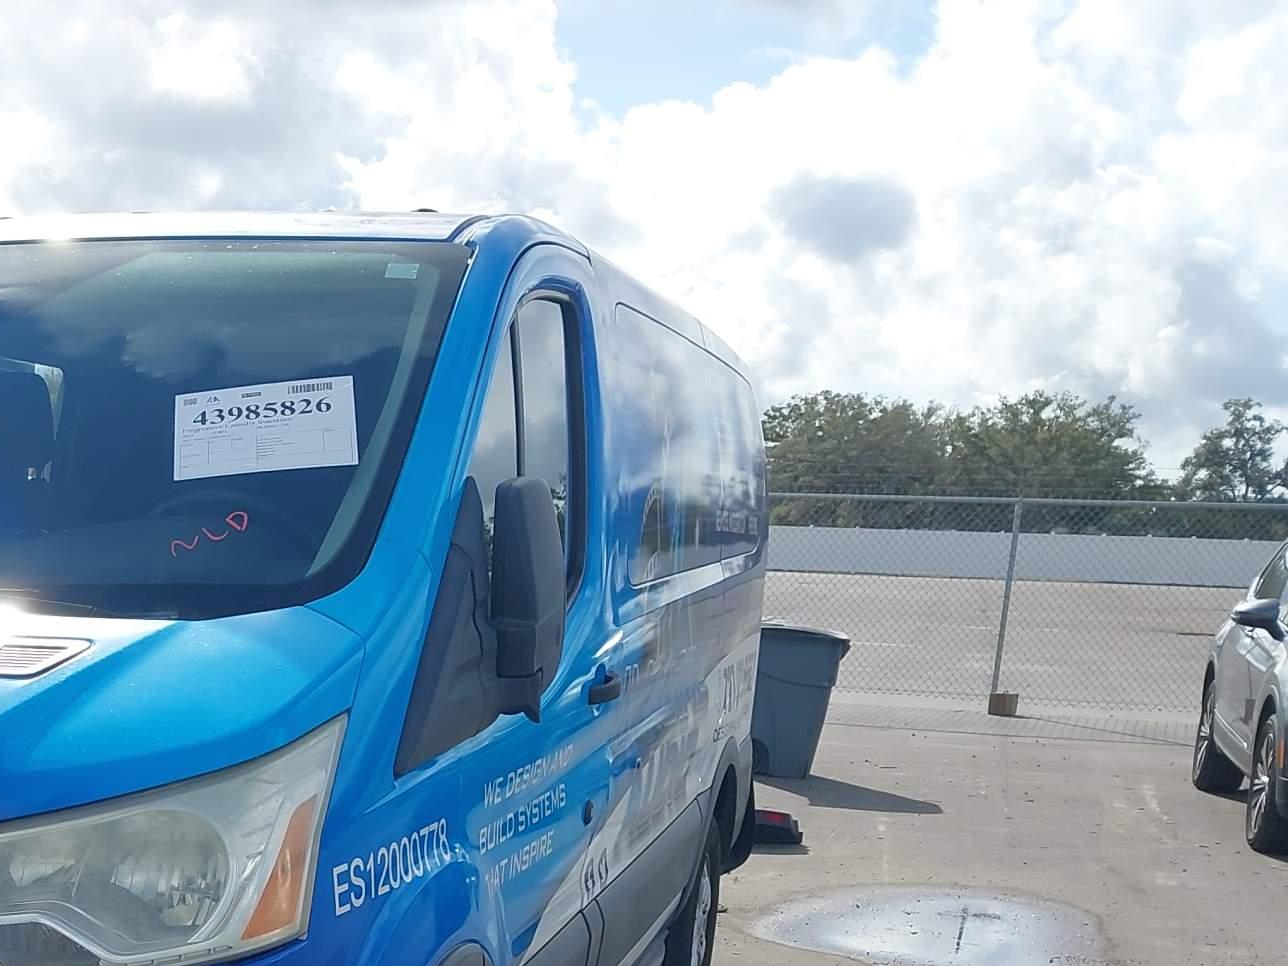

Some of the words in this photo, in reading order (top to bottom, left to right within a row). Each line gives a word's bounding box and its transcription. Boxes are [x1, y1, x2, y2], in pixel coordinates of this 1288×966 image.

[192, 396, 332, 426] 43985826
[483, 776, 504, 809] WE
[505, 754, 551, 799] DESIGN
[478, 812, 515, 856] BUILD
[517, 783, 567, 832] SYSTEMS
[331, 817, 452, 918] ES12000778
[508, 829, 555, 881] INSPIRE
